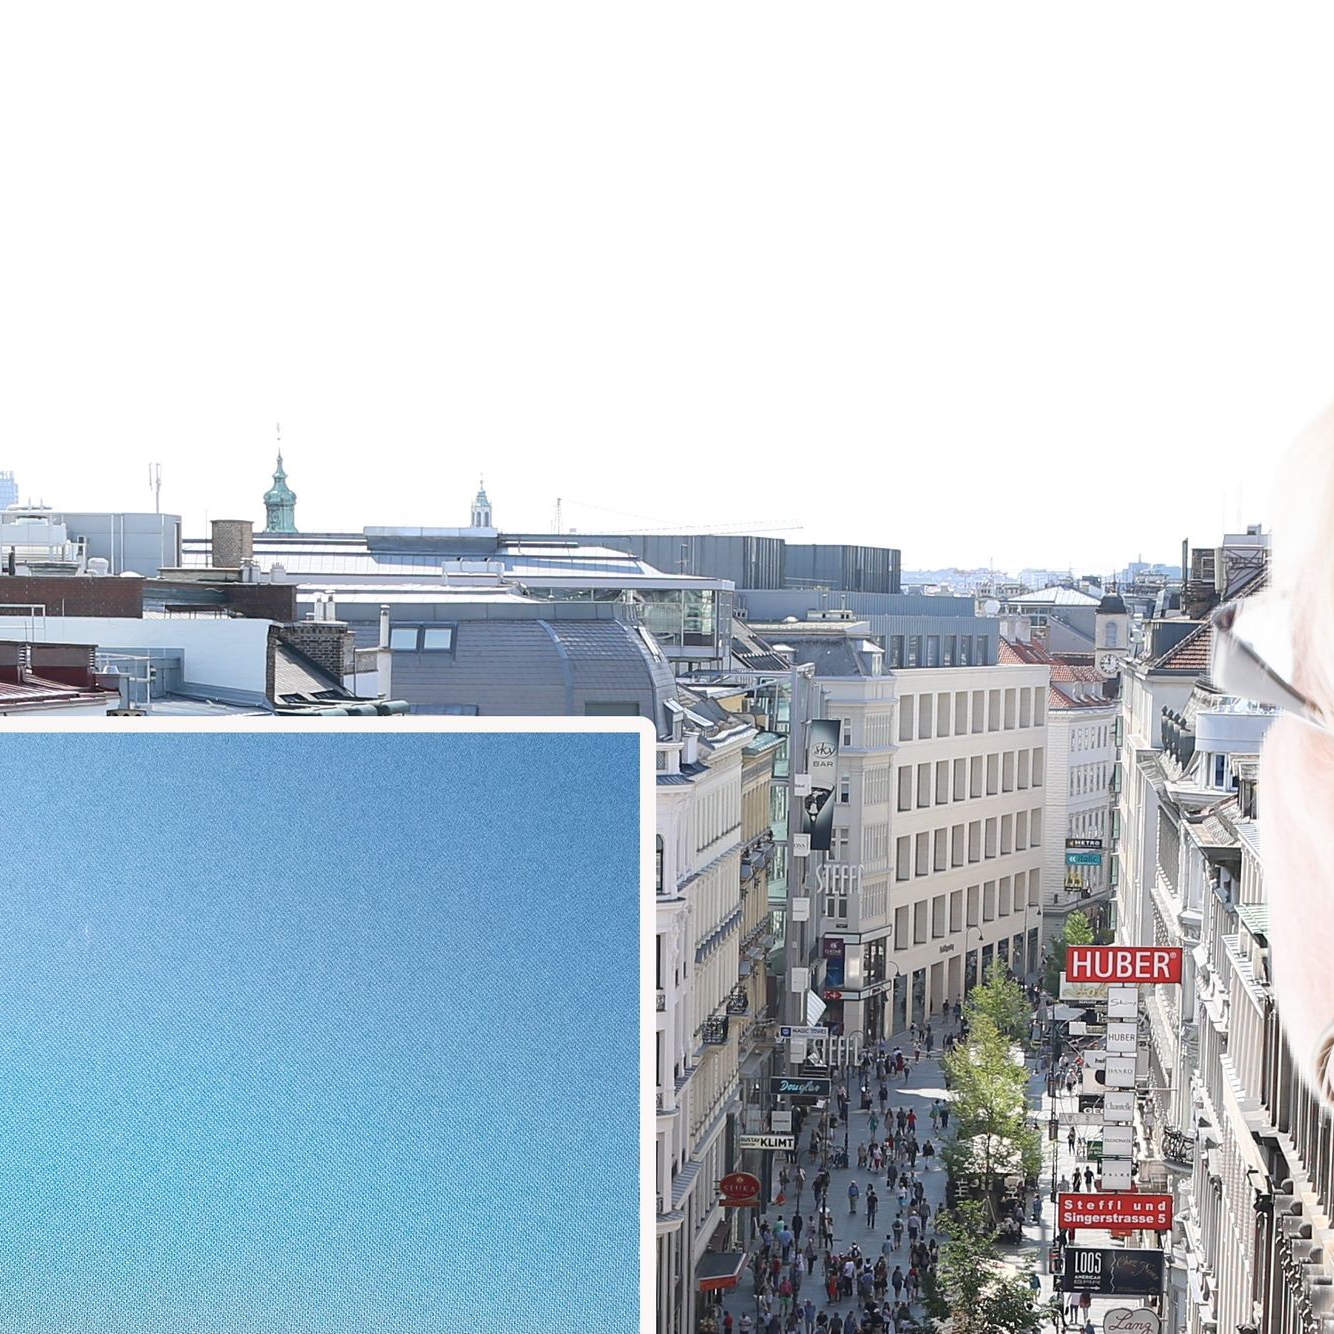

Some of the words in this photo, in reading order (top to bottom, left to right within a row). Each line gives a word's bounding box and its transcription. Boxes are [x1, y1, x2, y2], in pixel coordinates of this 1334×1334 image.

[814, 742, 836, 757] sky
[812, 760, 834, 768] BAR
[1108, 1033, 1135, 1041] HUBER
[779, 1079, 821, 1095] Douglas
[760, 1138, 794, 1147] KLIMT
[1063, 1199, 1122, 1210] Steffl
[1133, 1200, 1167, 1211] und
[1063, 1212, 1155, 1225] Singerstrasse
[1158, 1213, 1166, 1223] 5
[1074, 1251, 1102, 1274] LOOS
